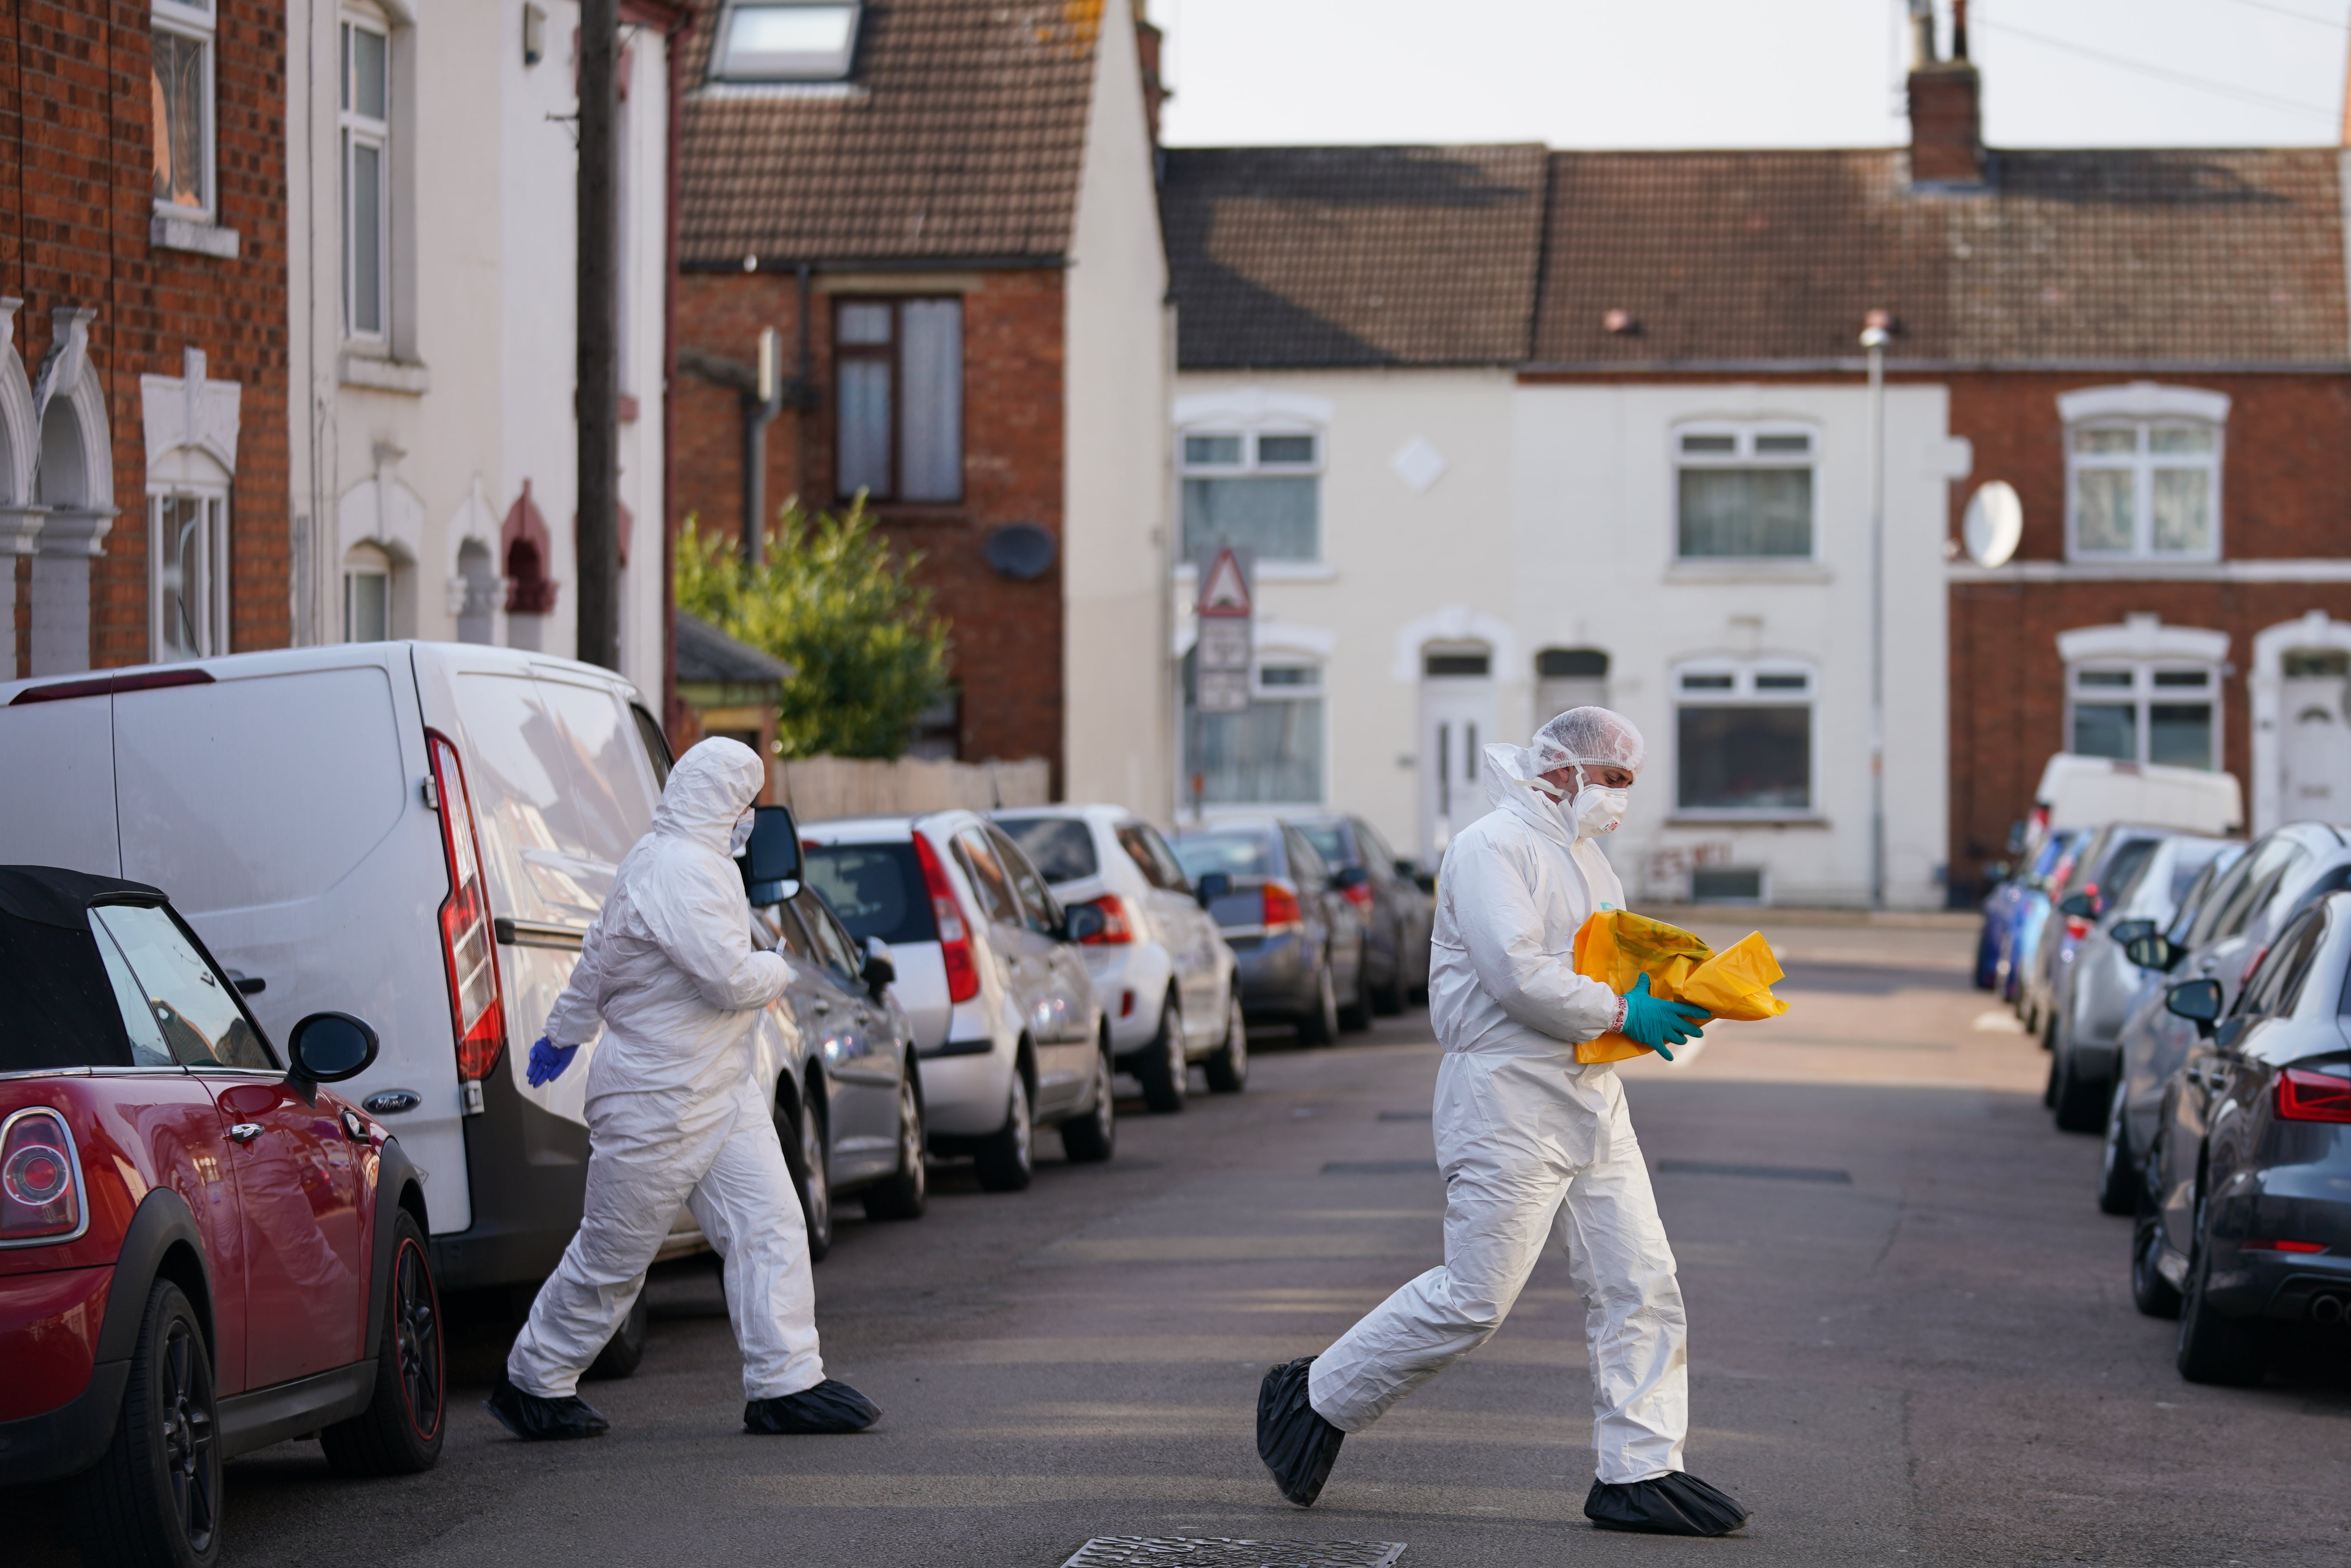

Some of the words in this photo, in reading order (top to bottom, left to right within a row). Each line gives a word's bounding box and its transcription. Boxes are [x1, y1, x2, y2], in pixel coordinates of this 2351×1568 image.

[376, 1095, 407, 1110] Ford
[1138, 1552, 1215, 1565] STANTON
[1176, 1553, 1251, 1565] DUCTILE
